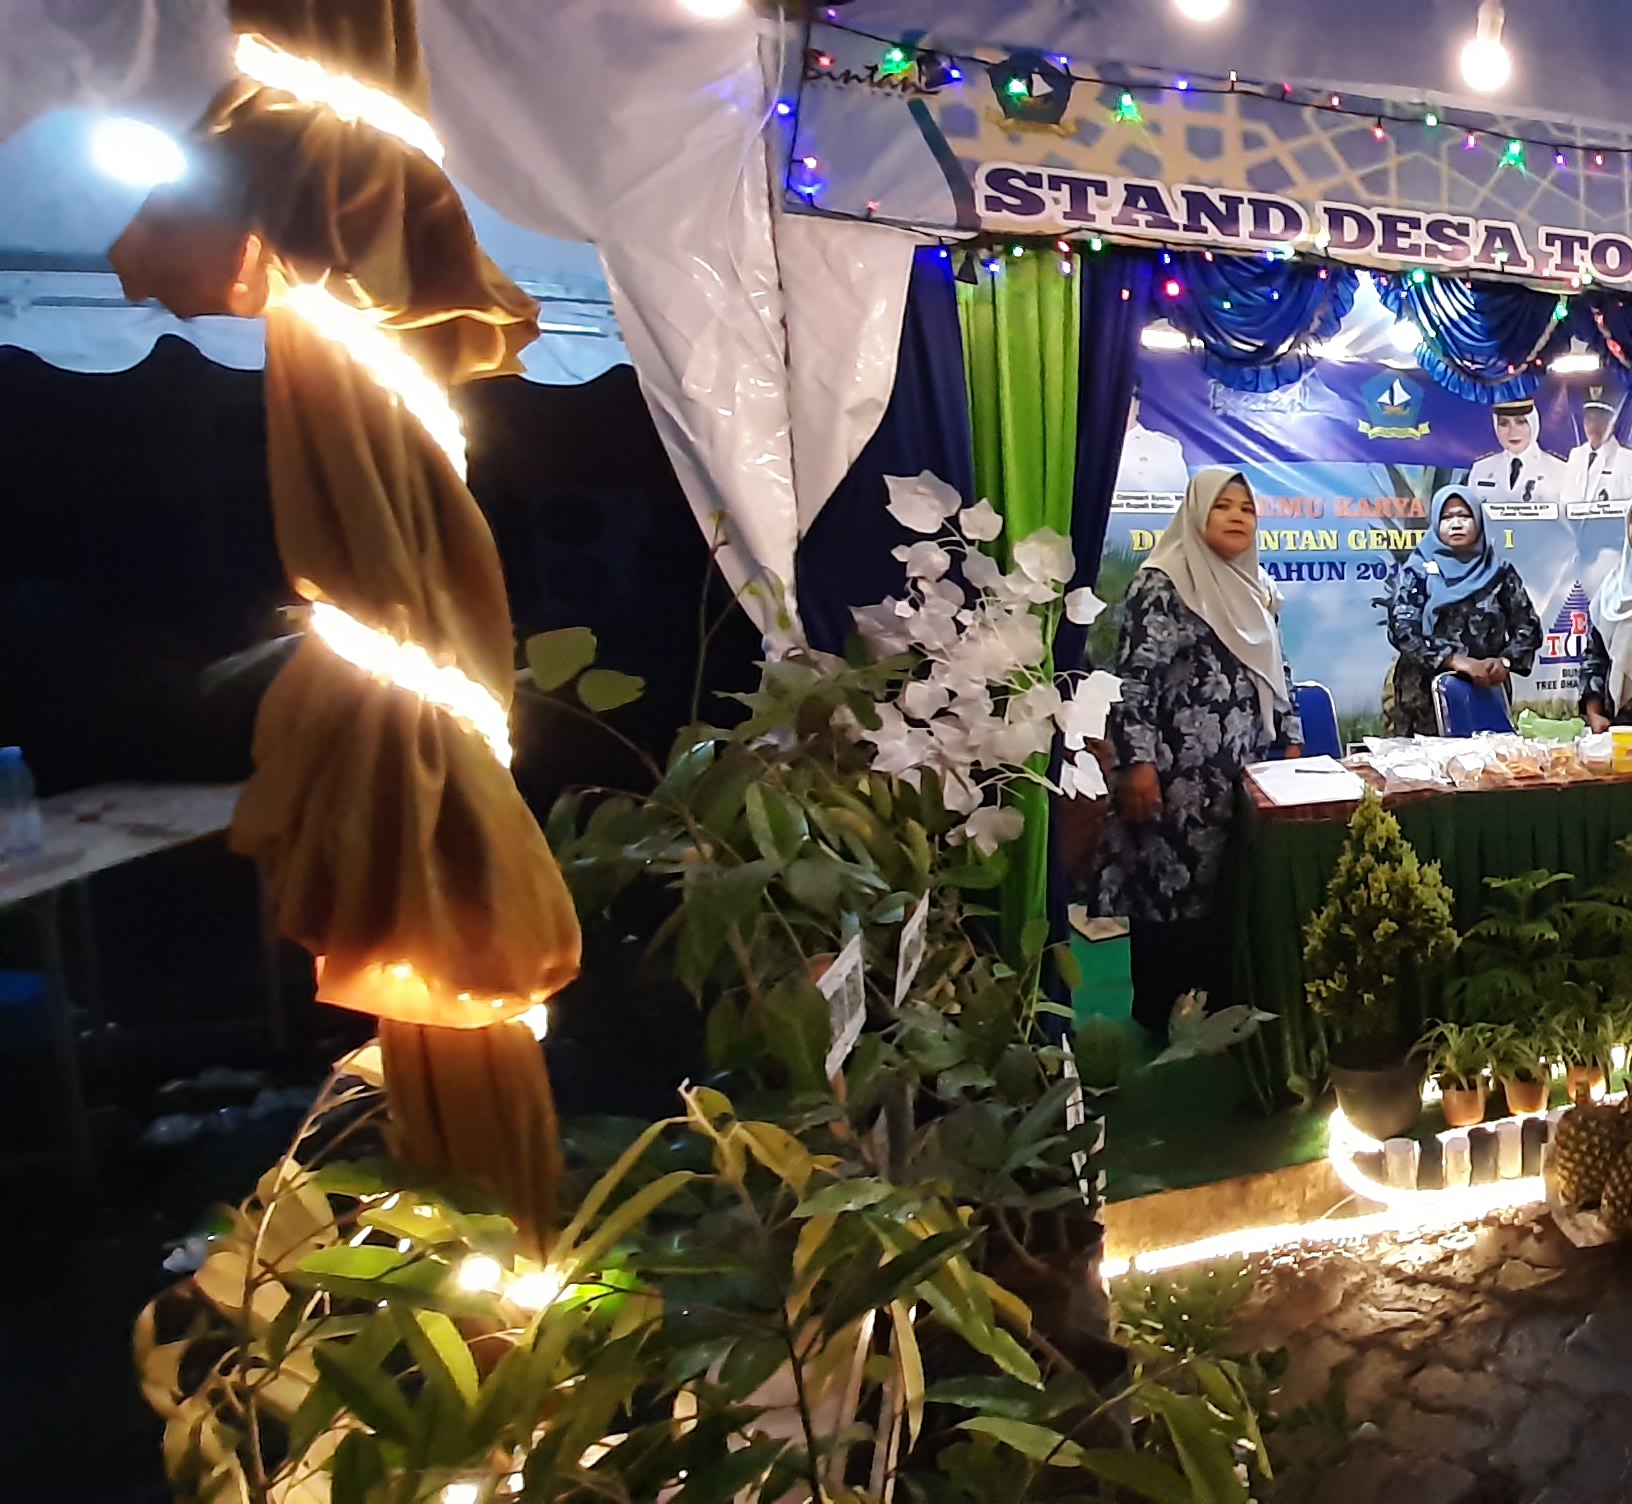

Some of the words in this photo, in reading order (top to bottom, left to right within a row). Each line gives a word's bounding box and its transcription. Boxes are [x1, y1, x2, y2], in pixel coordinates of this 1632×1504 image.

[984, 167, 1303, 242] STAND
[1323, 207, 1528, 268] DESA
[1257, 496, 1324, 518] EMU
[1335, 497, 1426, 518] KARYA
[1258, 530, 1338, 551] NTAN
[1259, 561, 1346, 582] AHUN
